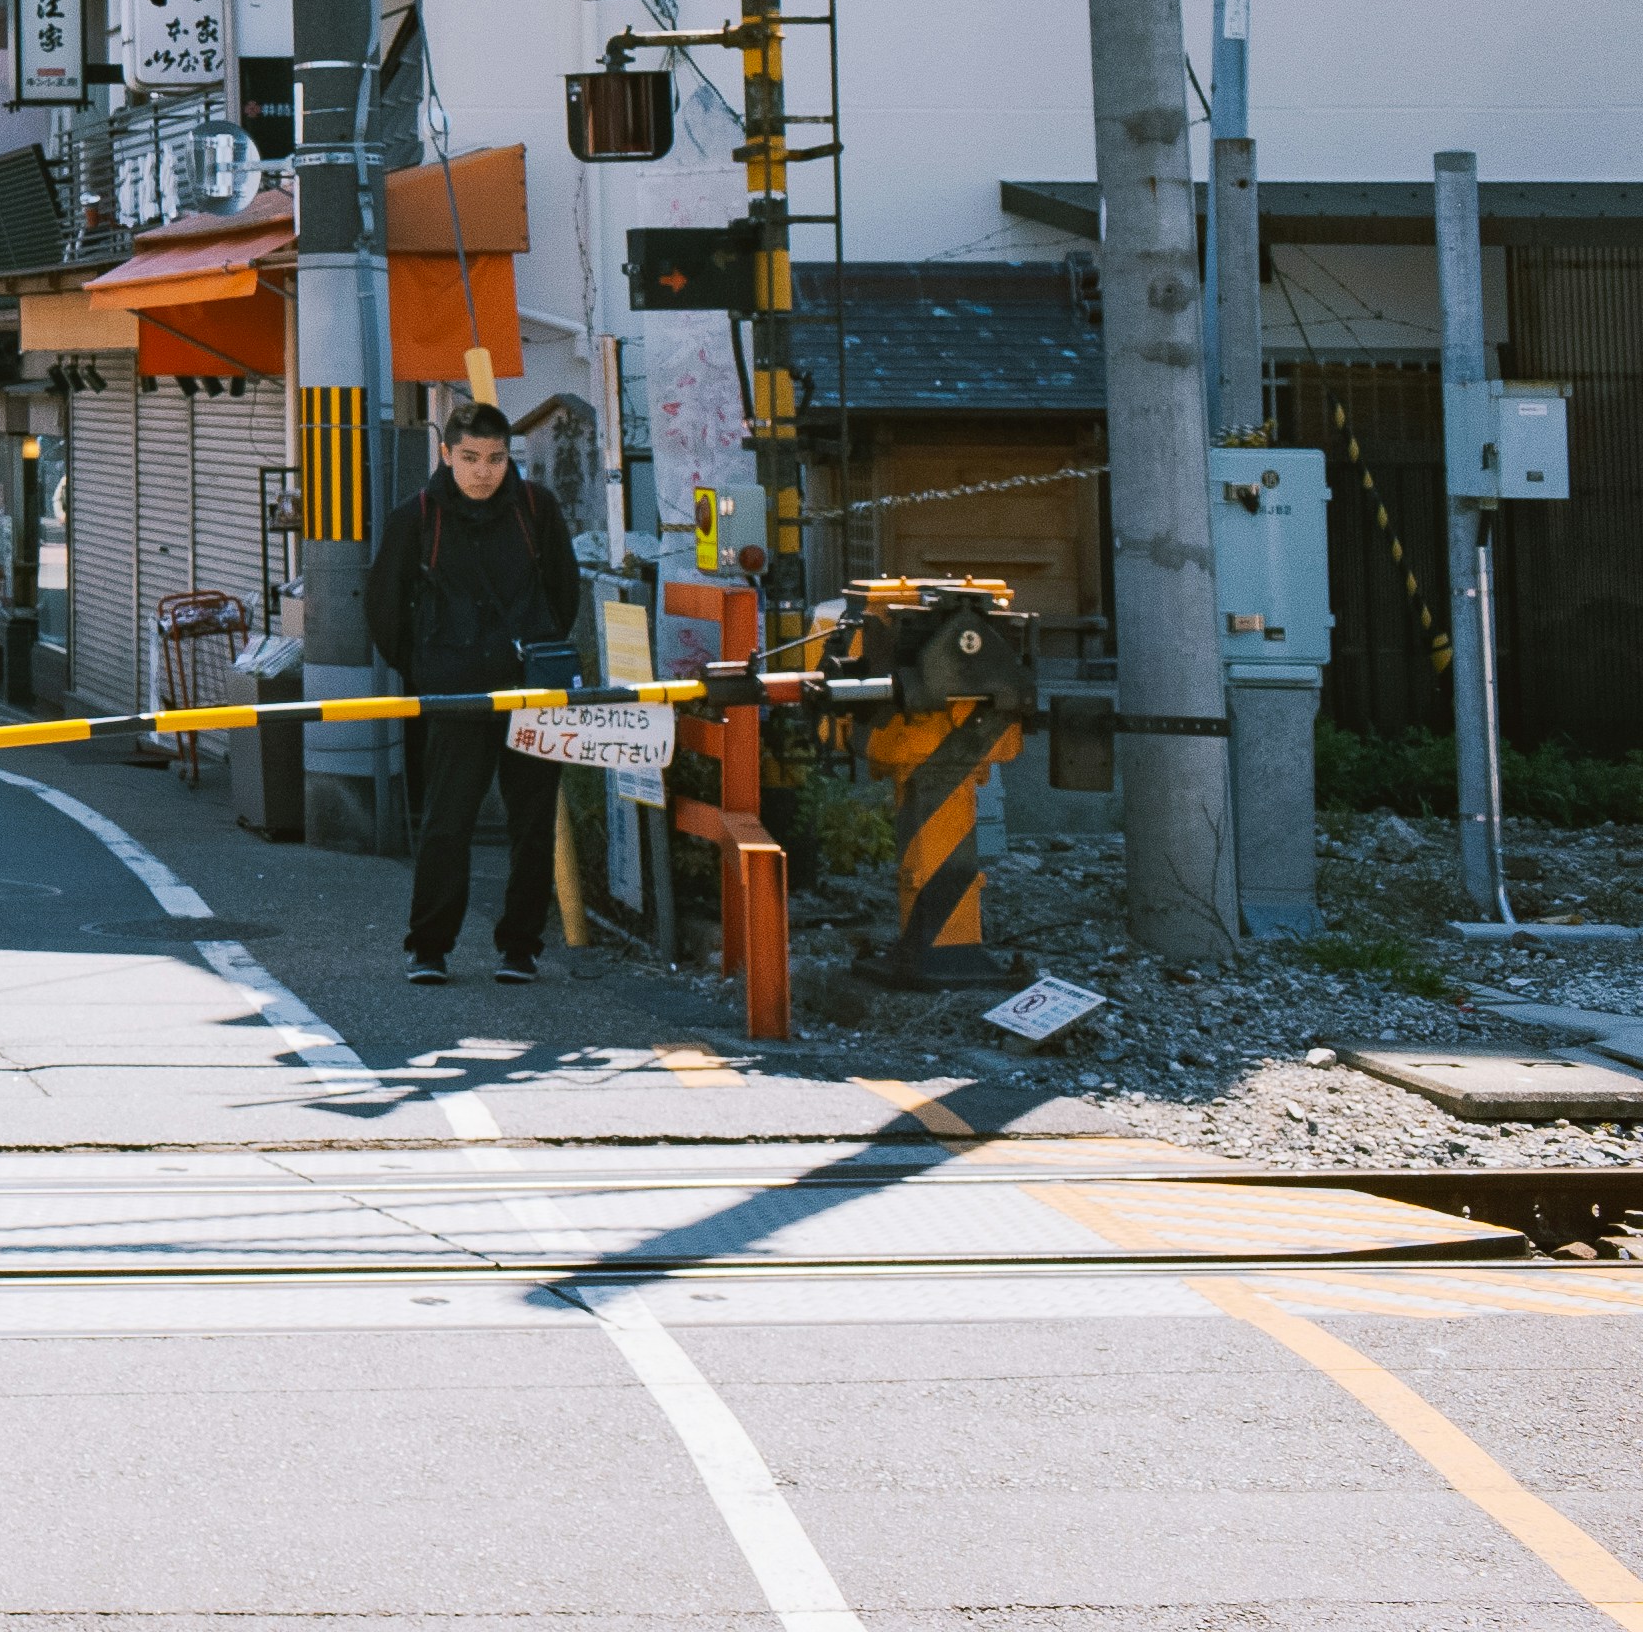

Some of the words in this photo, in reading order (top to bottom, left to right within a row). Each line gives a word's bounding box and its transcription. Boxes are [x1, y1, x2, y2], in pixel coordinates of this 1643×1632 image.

[537, 707, 651, 730] とじこめられたら
